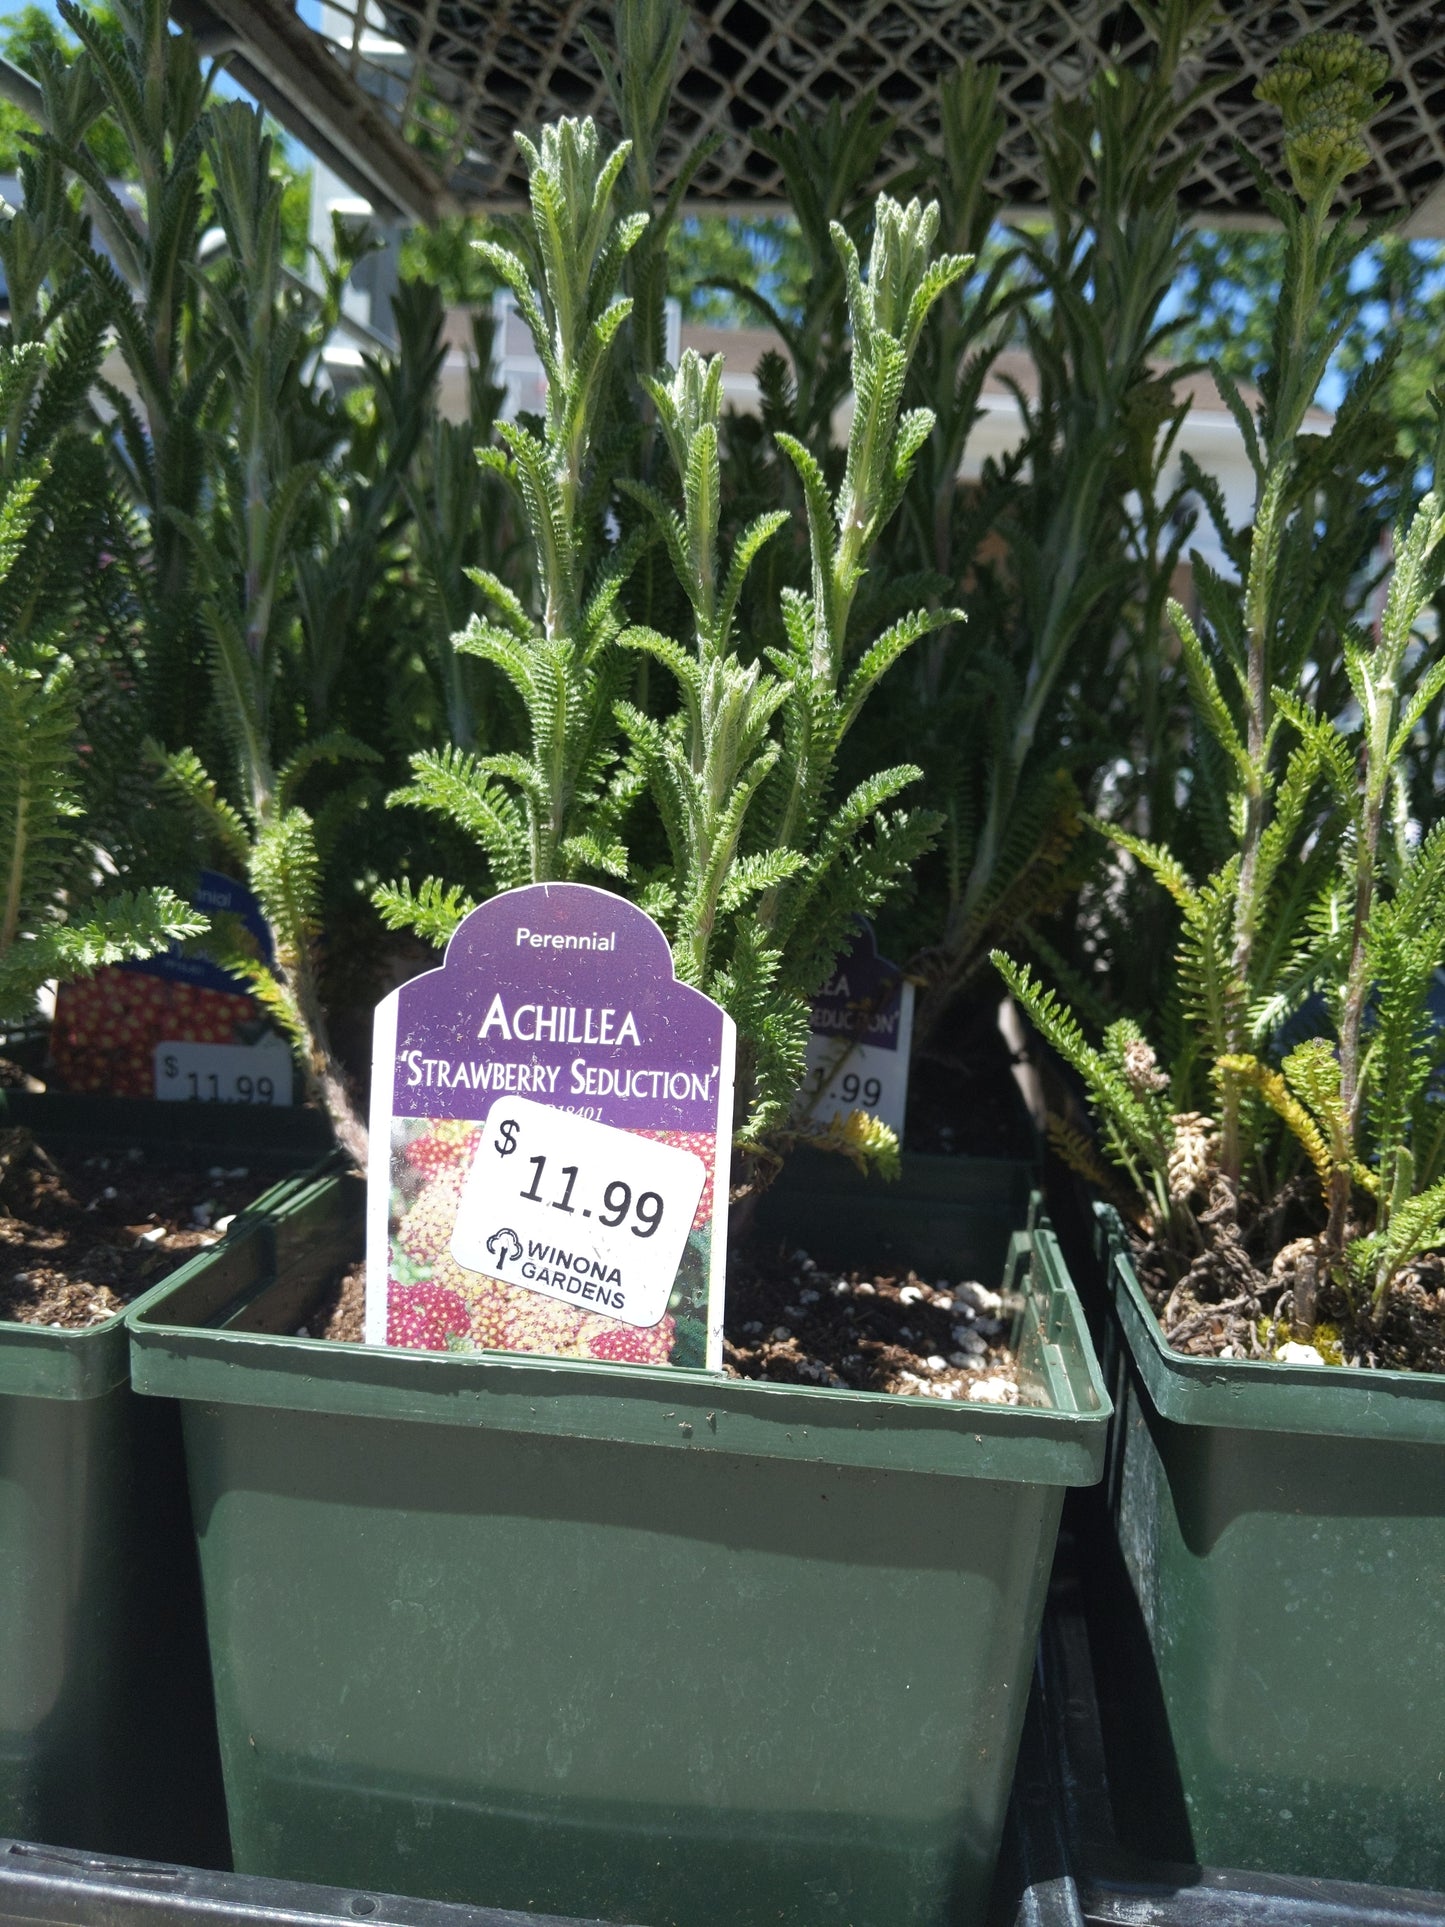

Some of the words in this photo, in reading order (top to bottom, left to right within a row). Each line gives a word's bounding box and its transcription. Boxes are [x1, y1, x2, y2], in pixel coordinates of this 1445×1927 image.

[516, 927, 615, 951] Perennial
[477, 992, 641, 1047] ACHILLEA
[164, 1055, 179, 1079] $
[188, 1072, 275, 1105] 11.99
[401, 1049, 561, 1094] 'STRAWBERRY
[570, 1057, 720, 1101] SEDUCTION'
[494, 1119, 521, 1158] $
[520, 1155, 665, 1239] 11.99
[521, 1262, 626, 1310] GARDENS
[527, 1239, 622, 1287] WINONA
